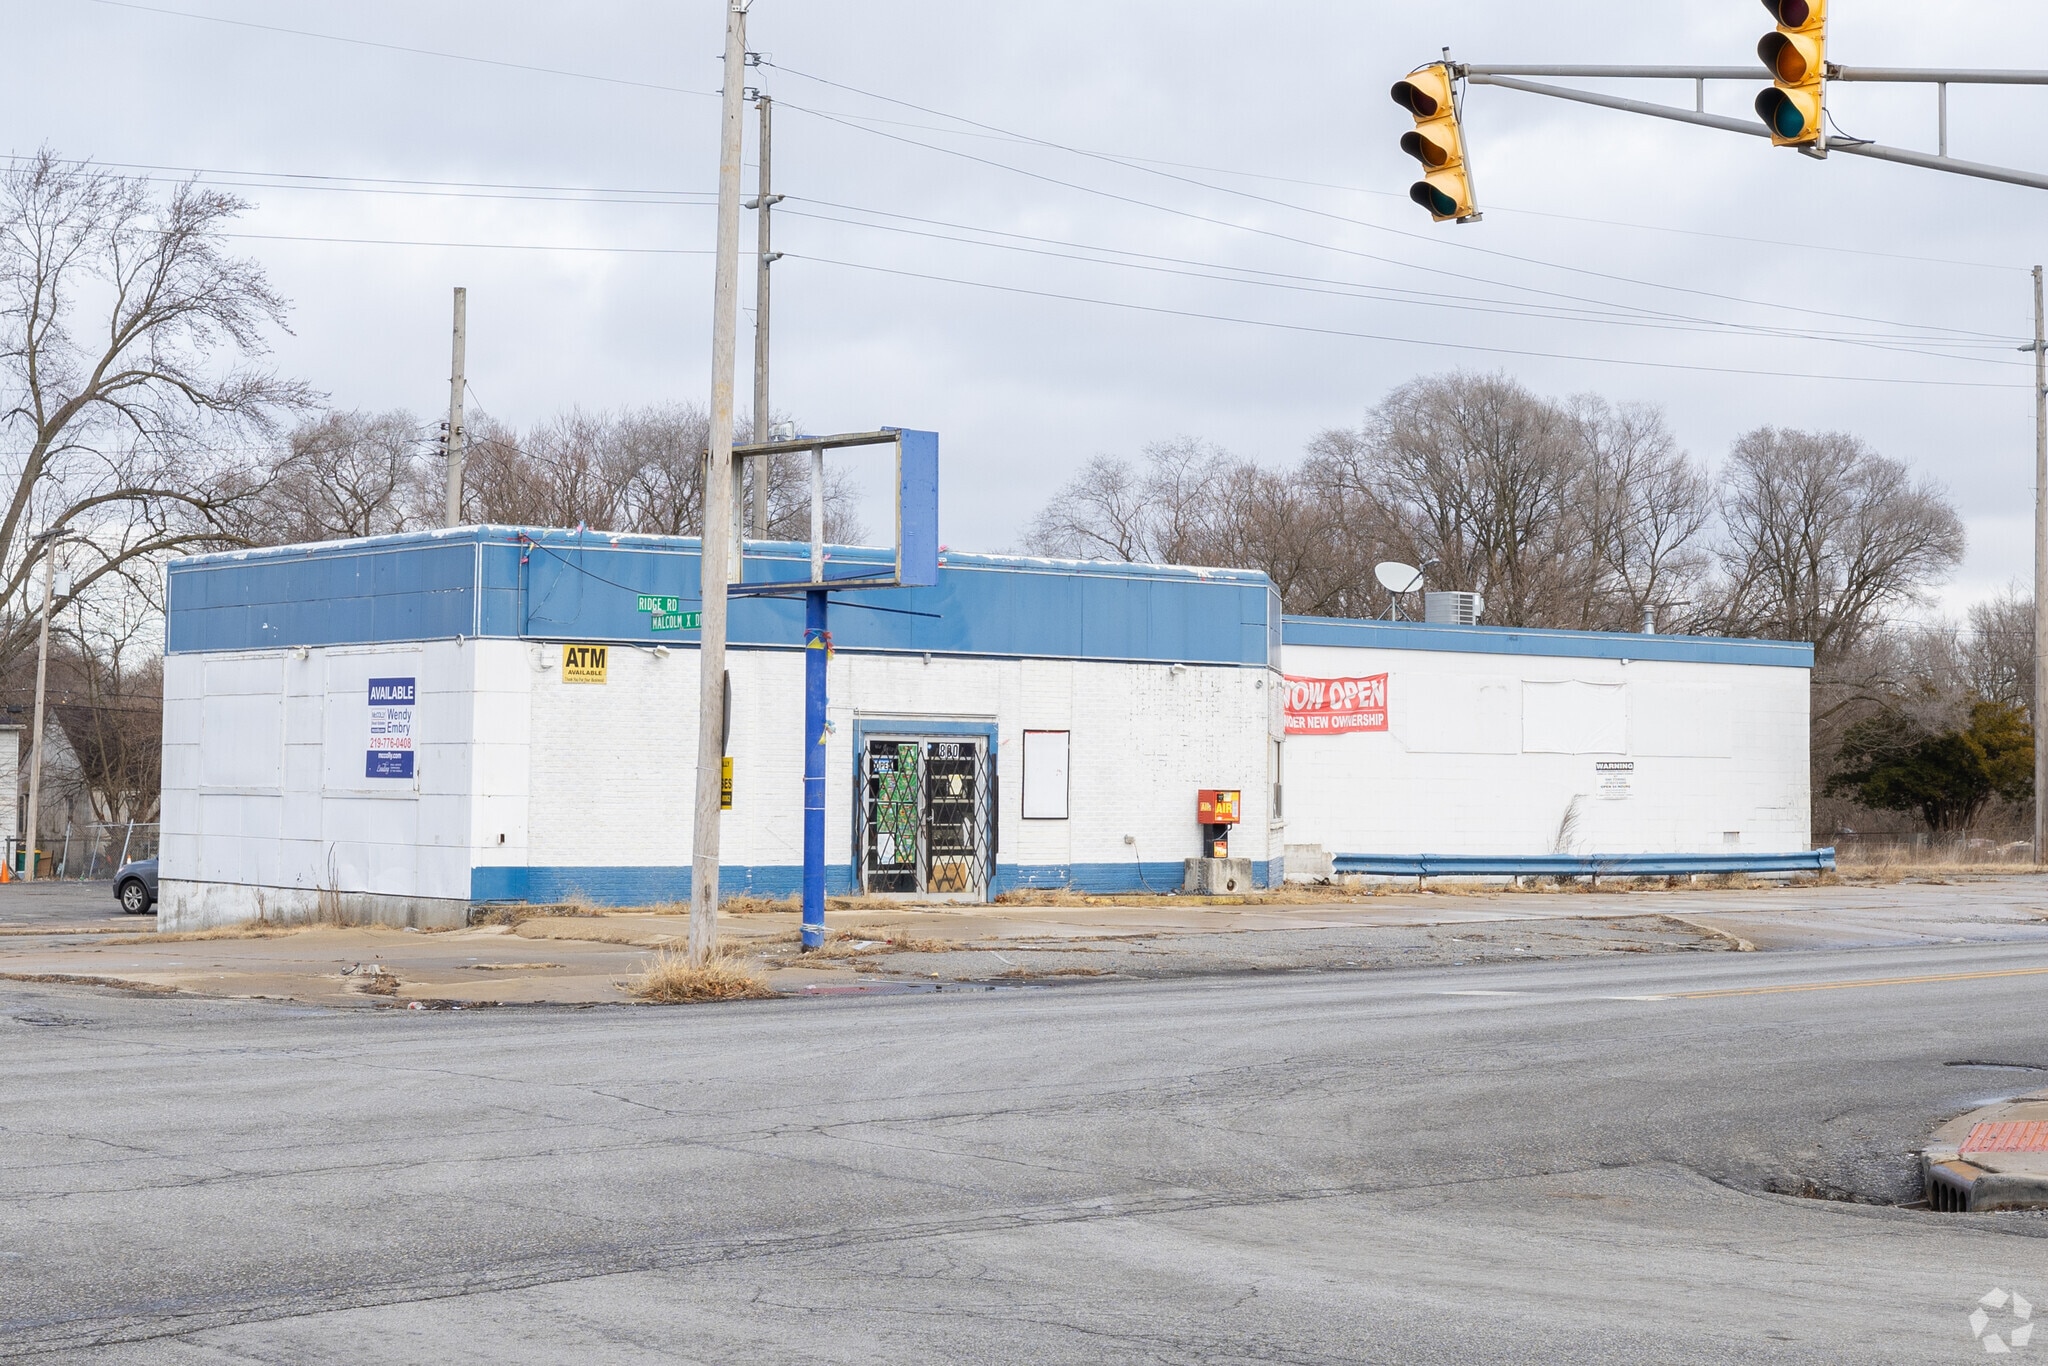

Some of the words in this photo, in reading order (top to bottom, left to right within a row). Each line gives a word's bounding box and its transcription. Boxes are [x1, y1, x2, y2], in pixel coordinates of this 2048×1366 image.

[638, 597, 662, 611] RIDGE
[666, 598, 678, 611] RD
[652, 614, 683, 630] MALCOLM
[686, 613, 692, 627] X
[565, 647, 606, 668] ATM
[370, 686, 414, 700] AVAILABLE
[1329, 679, 1385, 710] OPEN
[387, 708, 412, 723] Wendy
[1284, 714, 1306, 729] NDER
[1307, 715, 1329, 729] NEW
[1331, 713, 1385, 728] OWNERSHIP
[387, 721, 411, 736] Embry
[370, 737, 412, 748] 219-776-0408
[1216, 802, 1233, 814] AIR
